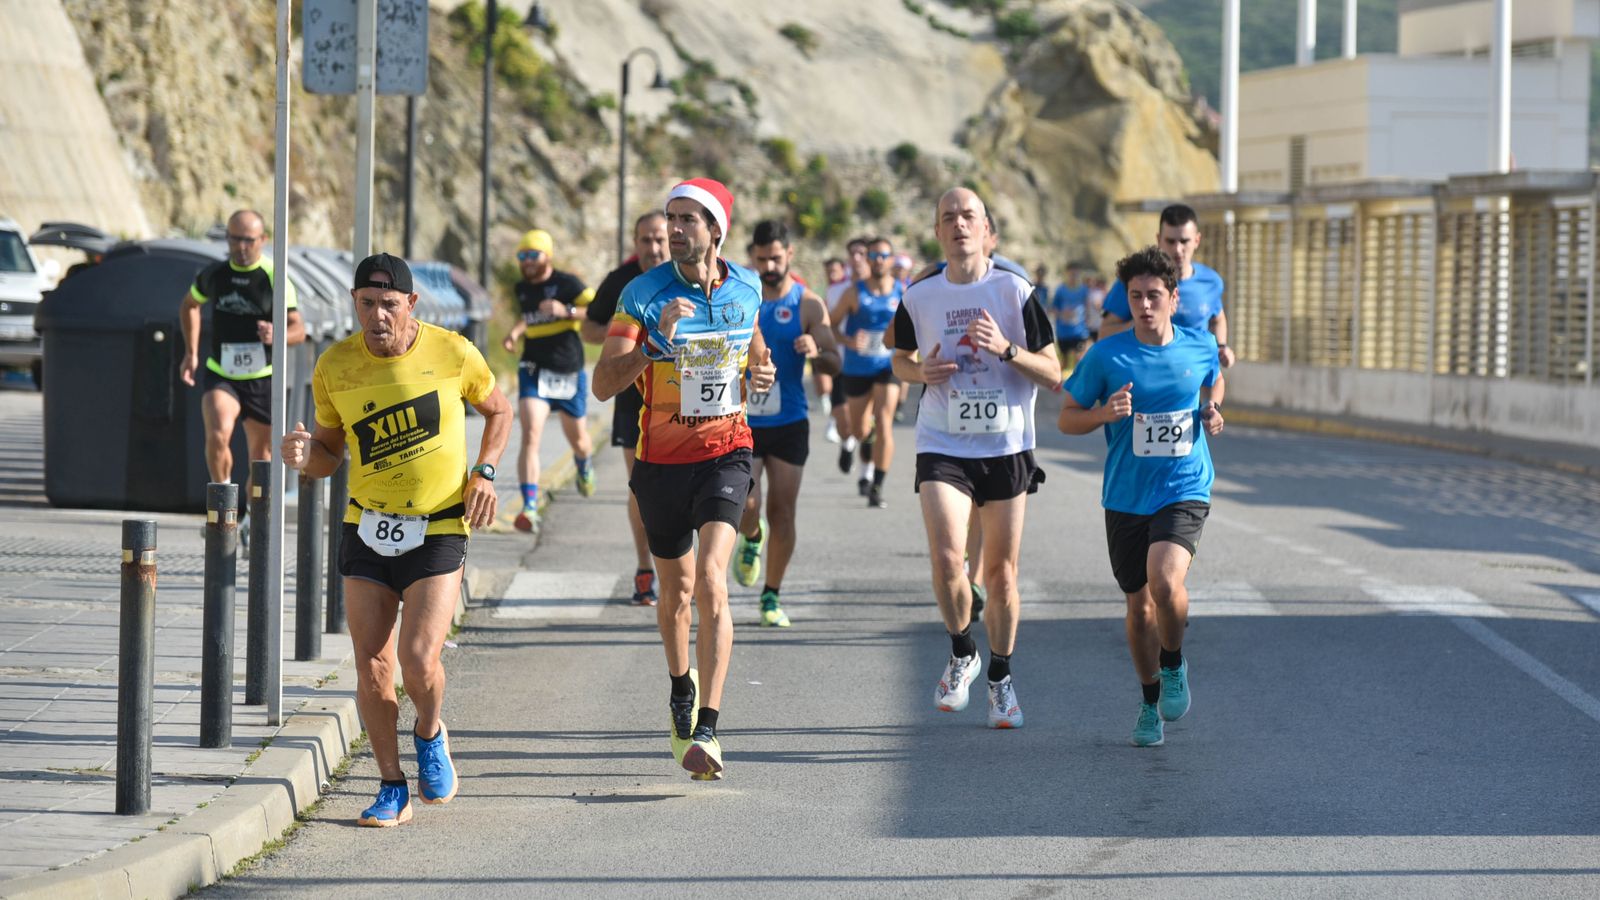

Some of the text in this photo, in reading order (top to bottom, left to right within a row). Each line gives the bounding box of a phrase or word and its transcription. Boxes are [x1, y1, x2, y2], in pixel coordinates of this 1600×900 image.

[952, 307, 983, 319] CARRERA
[233, 352, 253, 367] 85
[701, 382, 728, 403] 57
[959, 402, 998, 420] 210
[368, 406, 418, 443] XIII
[1145, 425, 1183, 443] 129
[399, 446, 425, 461] TARIFA
[375, 520, 405, 543] 86
